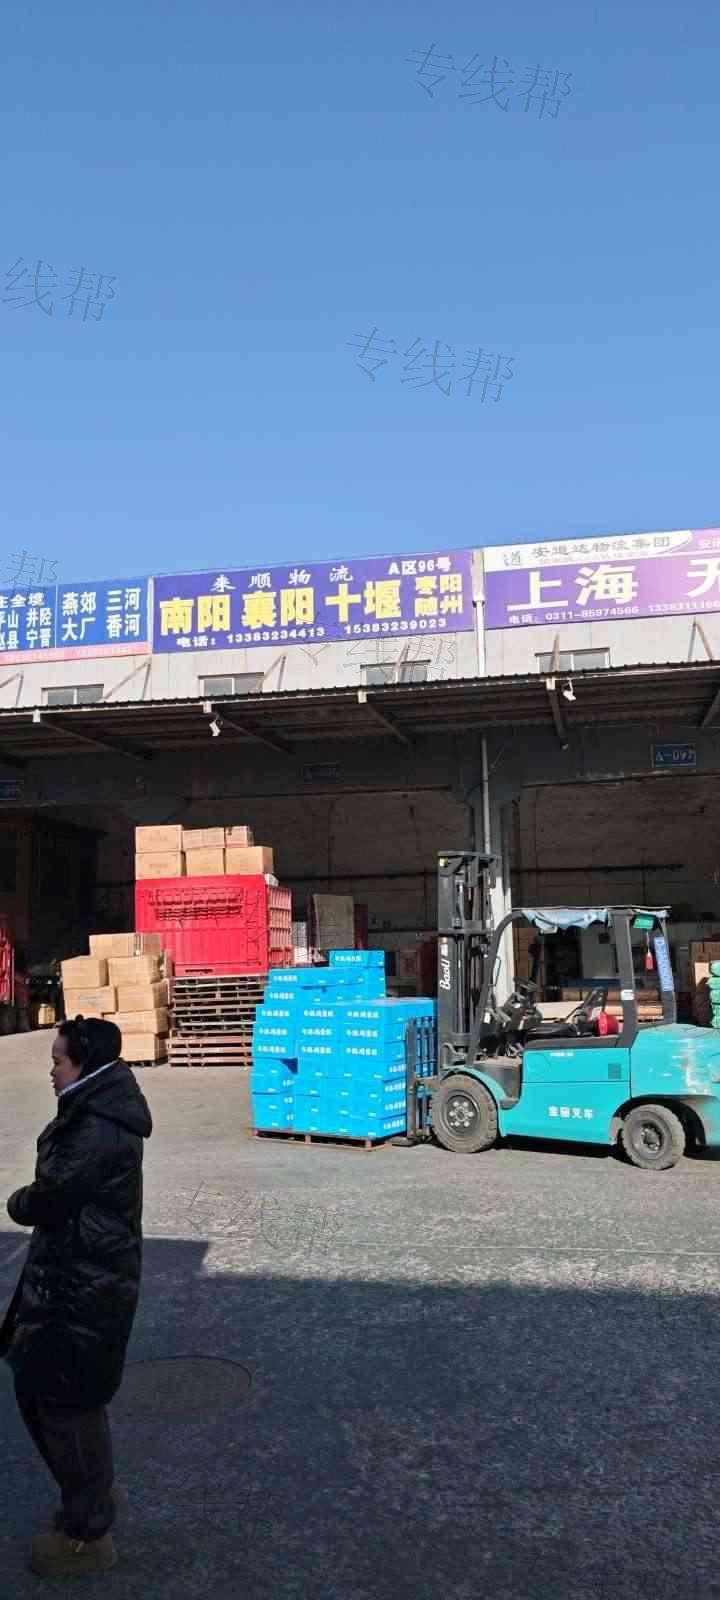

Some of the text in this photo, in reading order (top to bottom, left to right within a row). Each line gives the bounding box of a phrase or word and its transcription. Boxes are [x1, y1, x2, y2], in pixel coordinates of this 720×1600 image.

[62, 587, 141, 616] 燕郊 三河
[507, 564, 639, 612] 上海
[62, 613, 141, 640] 大厂 香河
[160, 579, 401, 636] 南阳 襄阳 十堰
